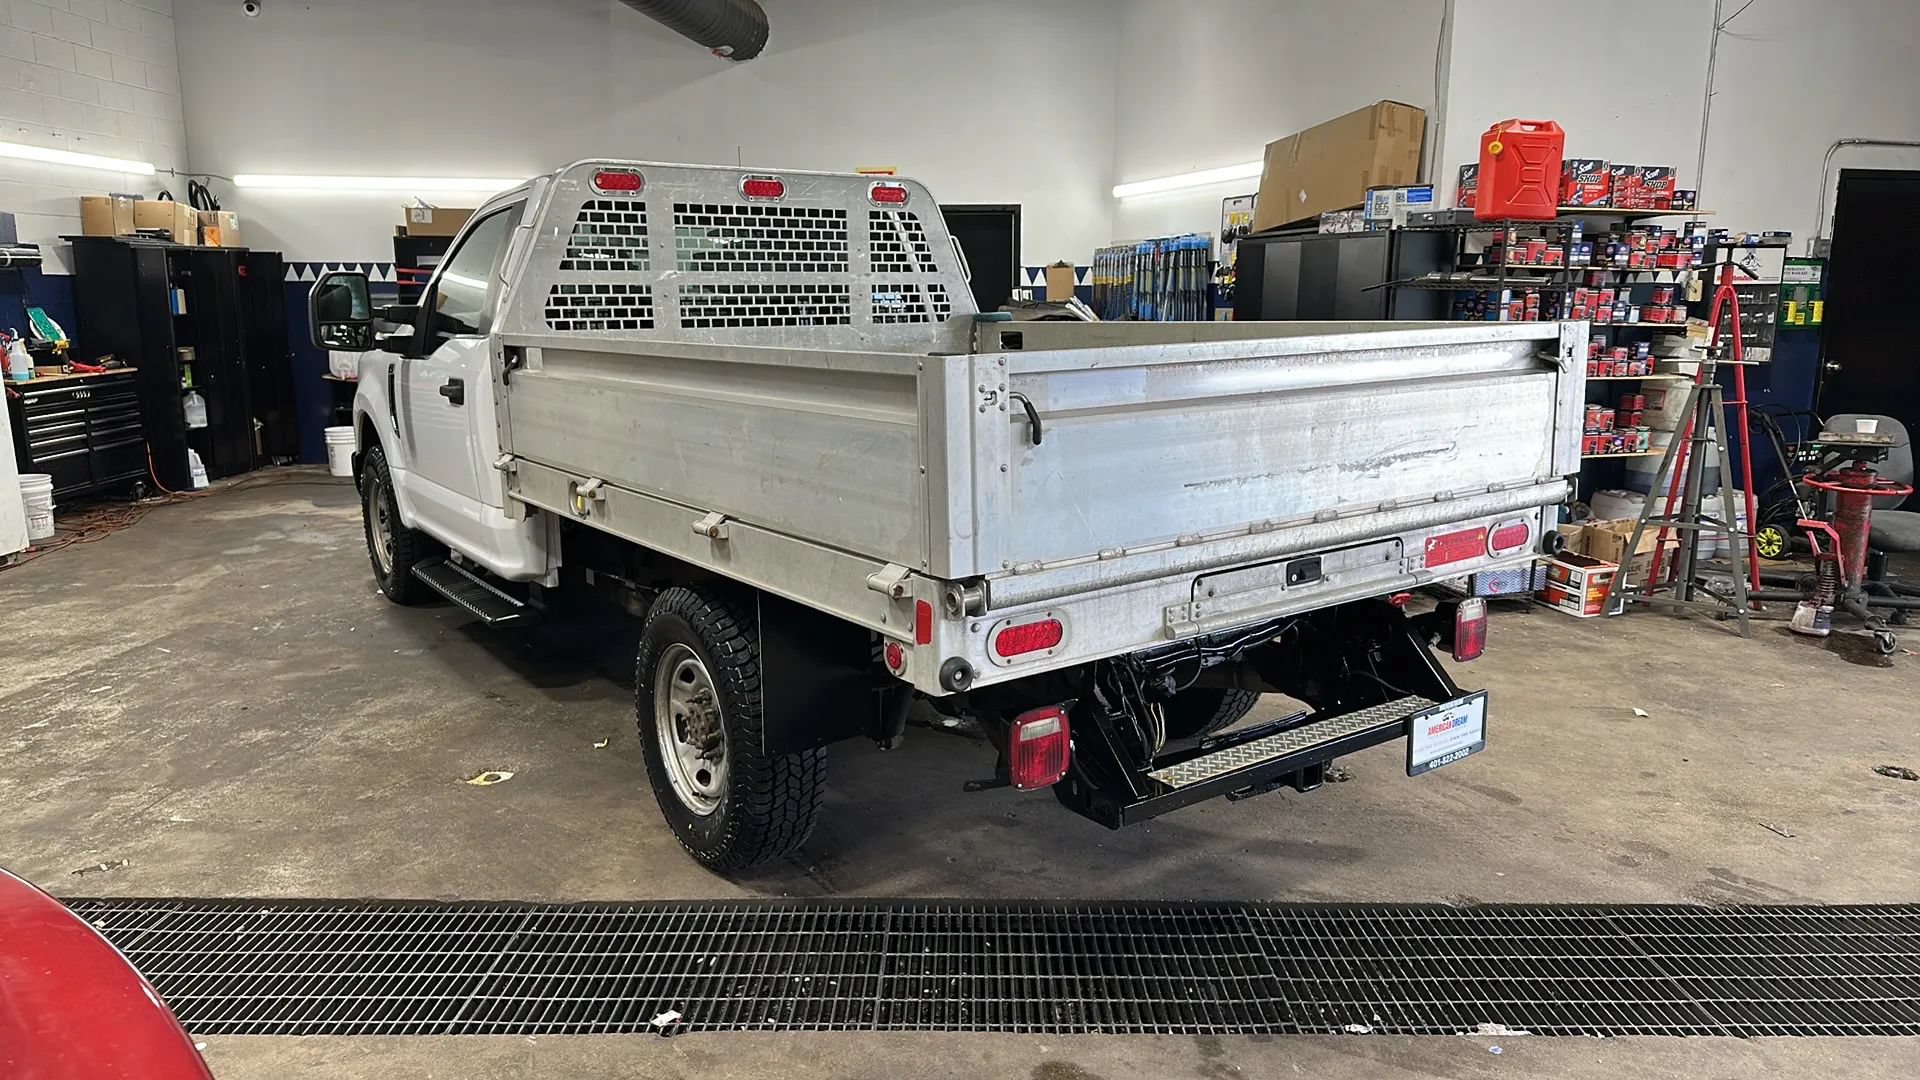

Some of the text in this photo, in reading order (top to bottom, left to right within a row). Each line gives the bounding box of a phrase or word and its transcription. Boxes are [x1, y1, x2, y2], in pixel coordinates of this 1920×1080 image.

[1577, 174, 1602, 183] SHOP
[1644, 180, 1668, 190] SHOP
[1427, 719, 1453, 736] AMERICAN
[1452, 714, 1468, 728] DREAM
